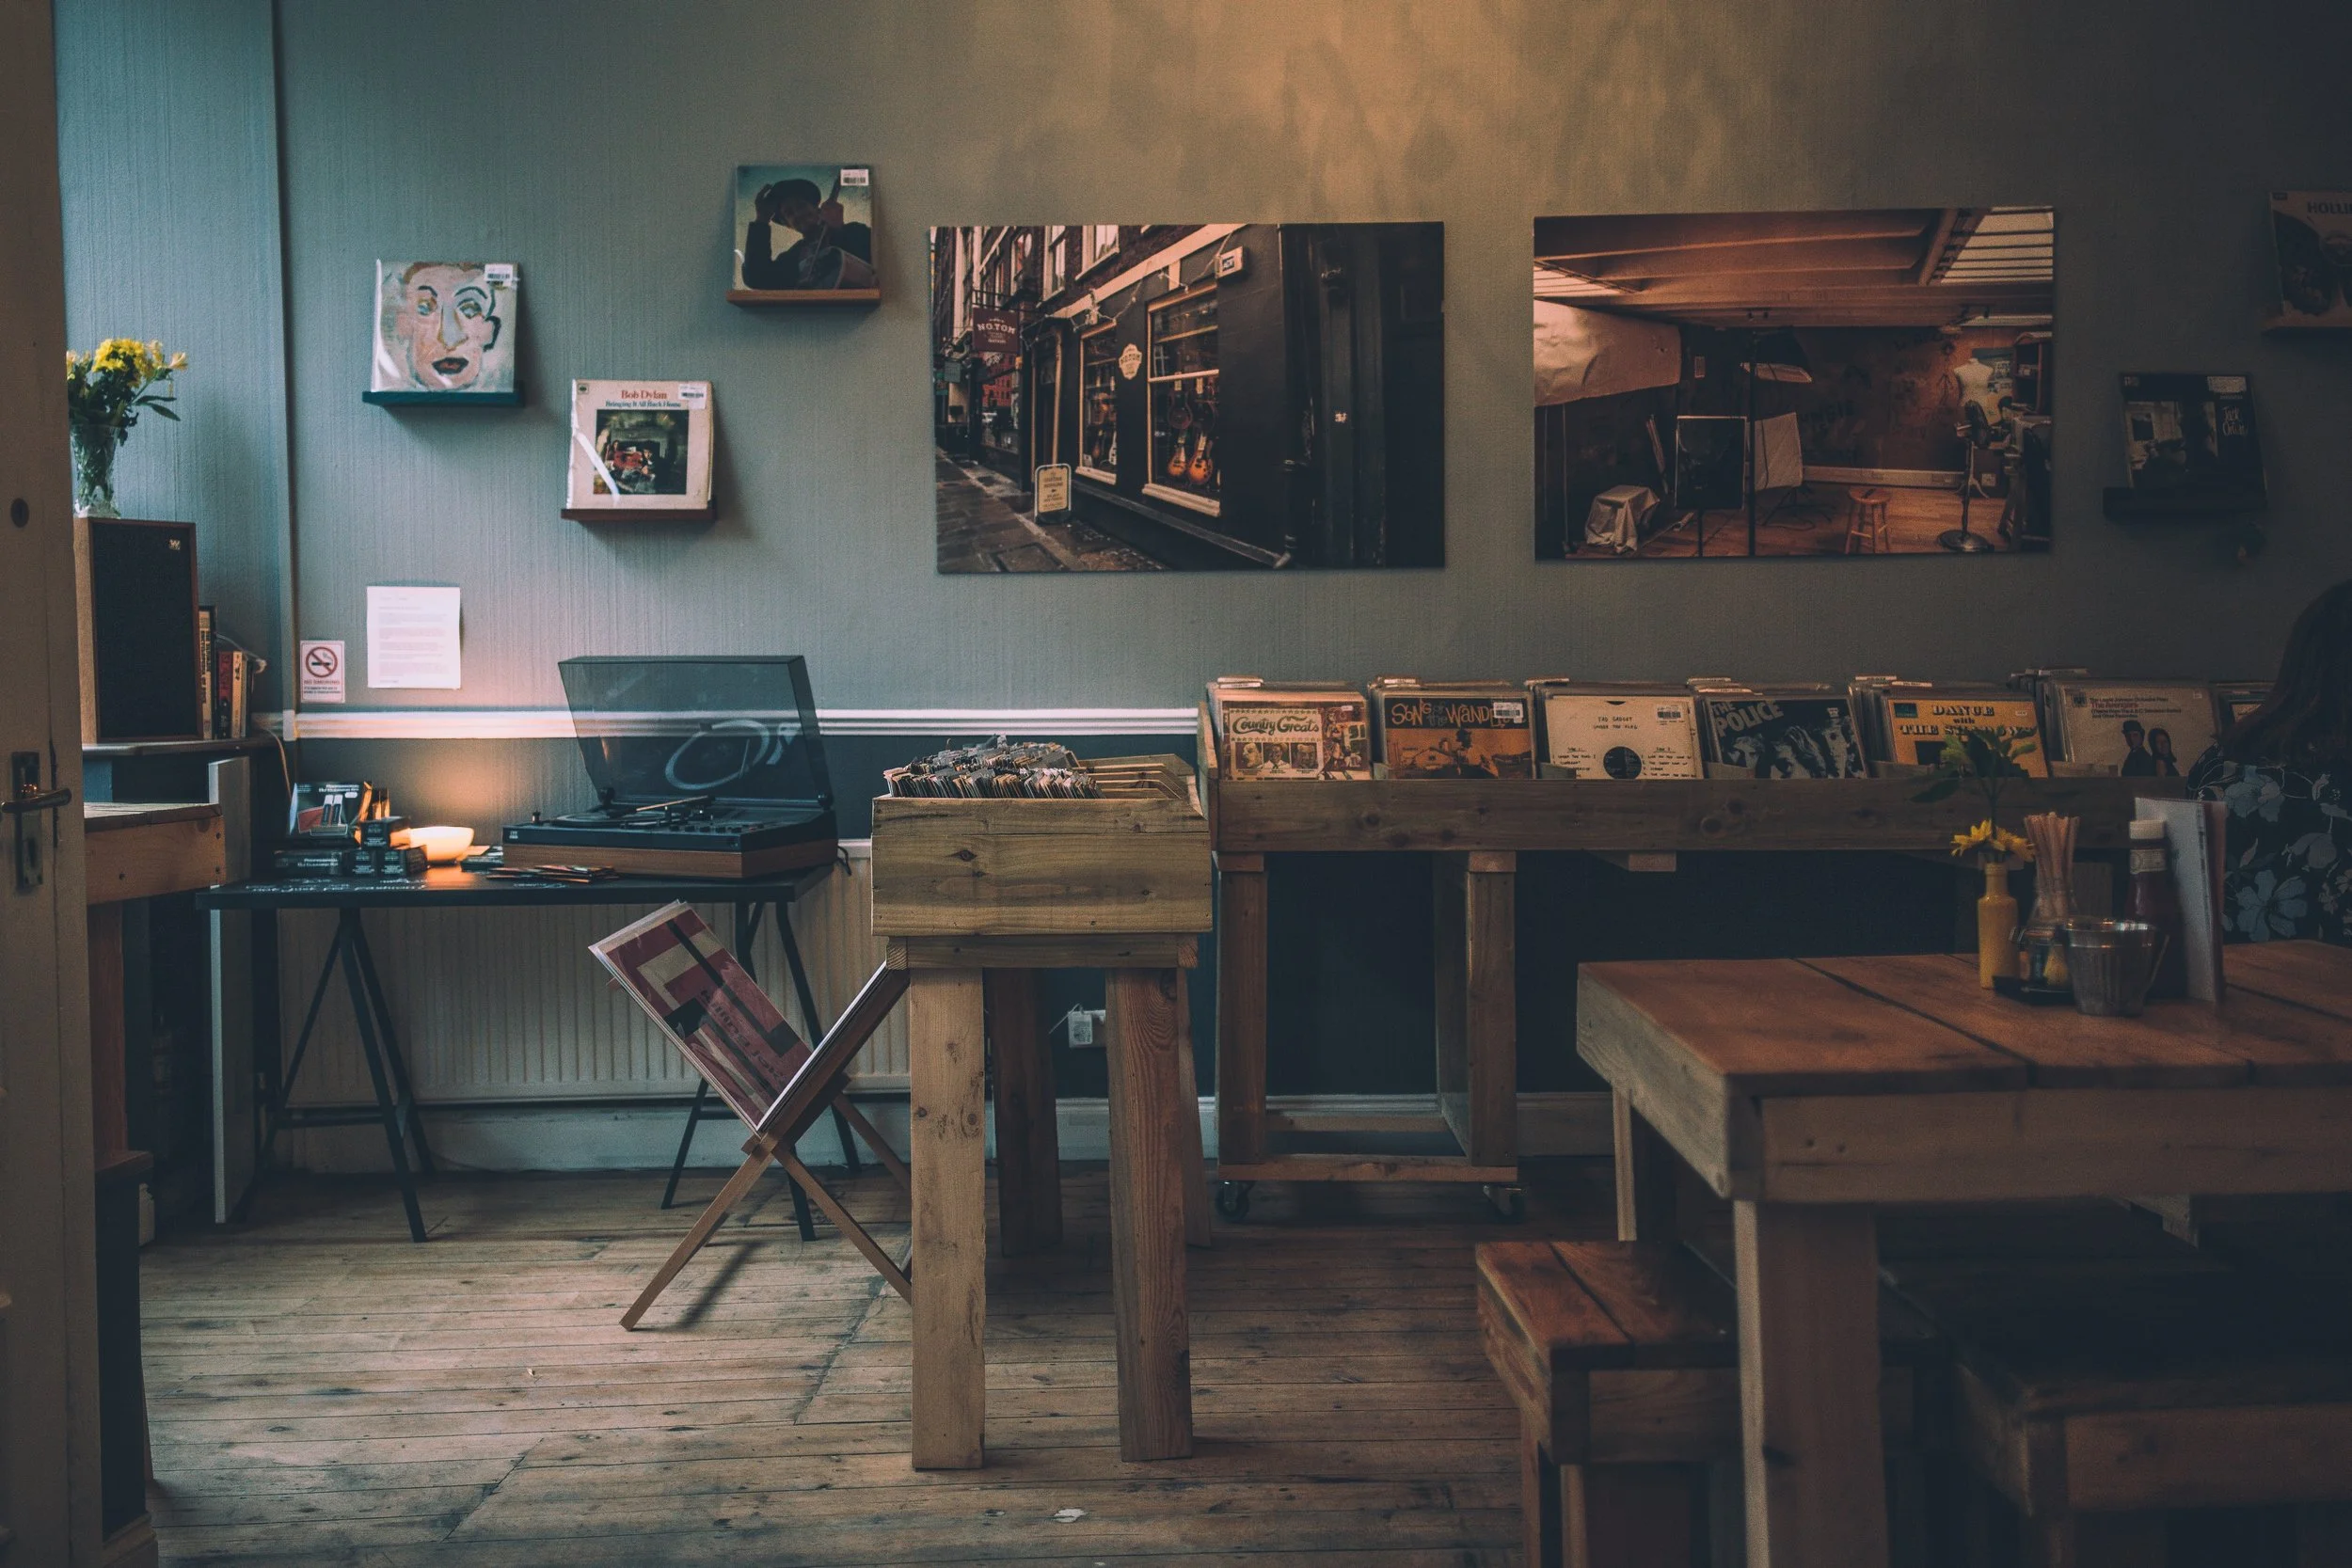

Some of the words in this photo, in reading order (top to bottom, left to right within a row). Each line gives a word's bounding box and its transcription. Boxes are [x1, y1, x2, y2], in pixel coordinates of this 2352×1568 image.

[621, 389, 639, 399] Bob
[641, 389, 668, 401] Dylan
[605, 401, 630, 409] Bringing
[1712, 702, 1736, 716] THE
[1933, 705, 1995, 717] DANCE
[1715, 701, 1784, 737] POLICE
[1232, 716, 1277, 736] Country
[1277, 716, 1319, 734] Greats
[1899, 725, 1940, 736] THE
[1944, 725, 2037, 736] SHDOWS
